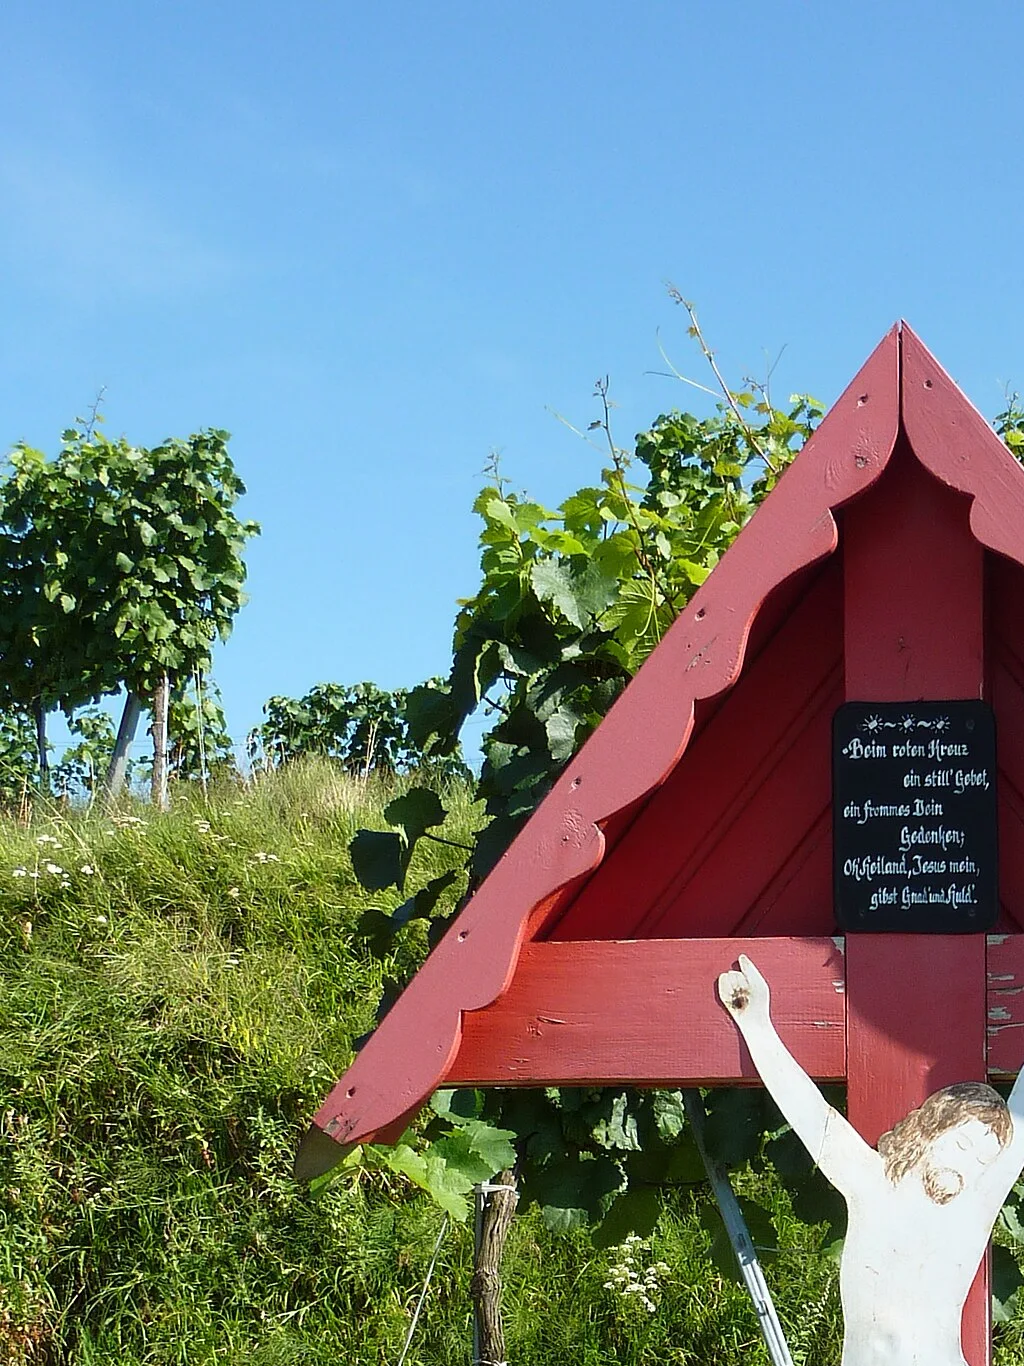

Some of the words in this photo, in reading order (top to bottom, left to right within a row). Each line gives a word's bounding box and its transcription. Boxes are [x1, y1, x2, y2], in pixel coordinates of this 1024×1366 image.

[848, 738, 887, 760] Beim
[892, 739, 926, 758] roten
[928, 739, 970, 762] Kreuz
[903, 768, 922, 788] ein
[924, 769, 954, 788] still'
[953, 769, 990, 794] Gebet,
[843, 801, 862, 818] ein
[857, 799, 911, 824] frommes
[912, 798, 944, 817] Dein
[898, 825, 966, 851] Gedenken;
[911, 855, 947, 876] Jesus
[949, 857, 981, 877] mein,
[868, 886, 899, 910] gibst
[928, 887, 946, 904] und
